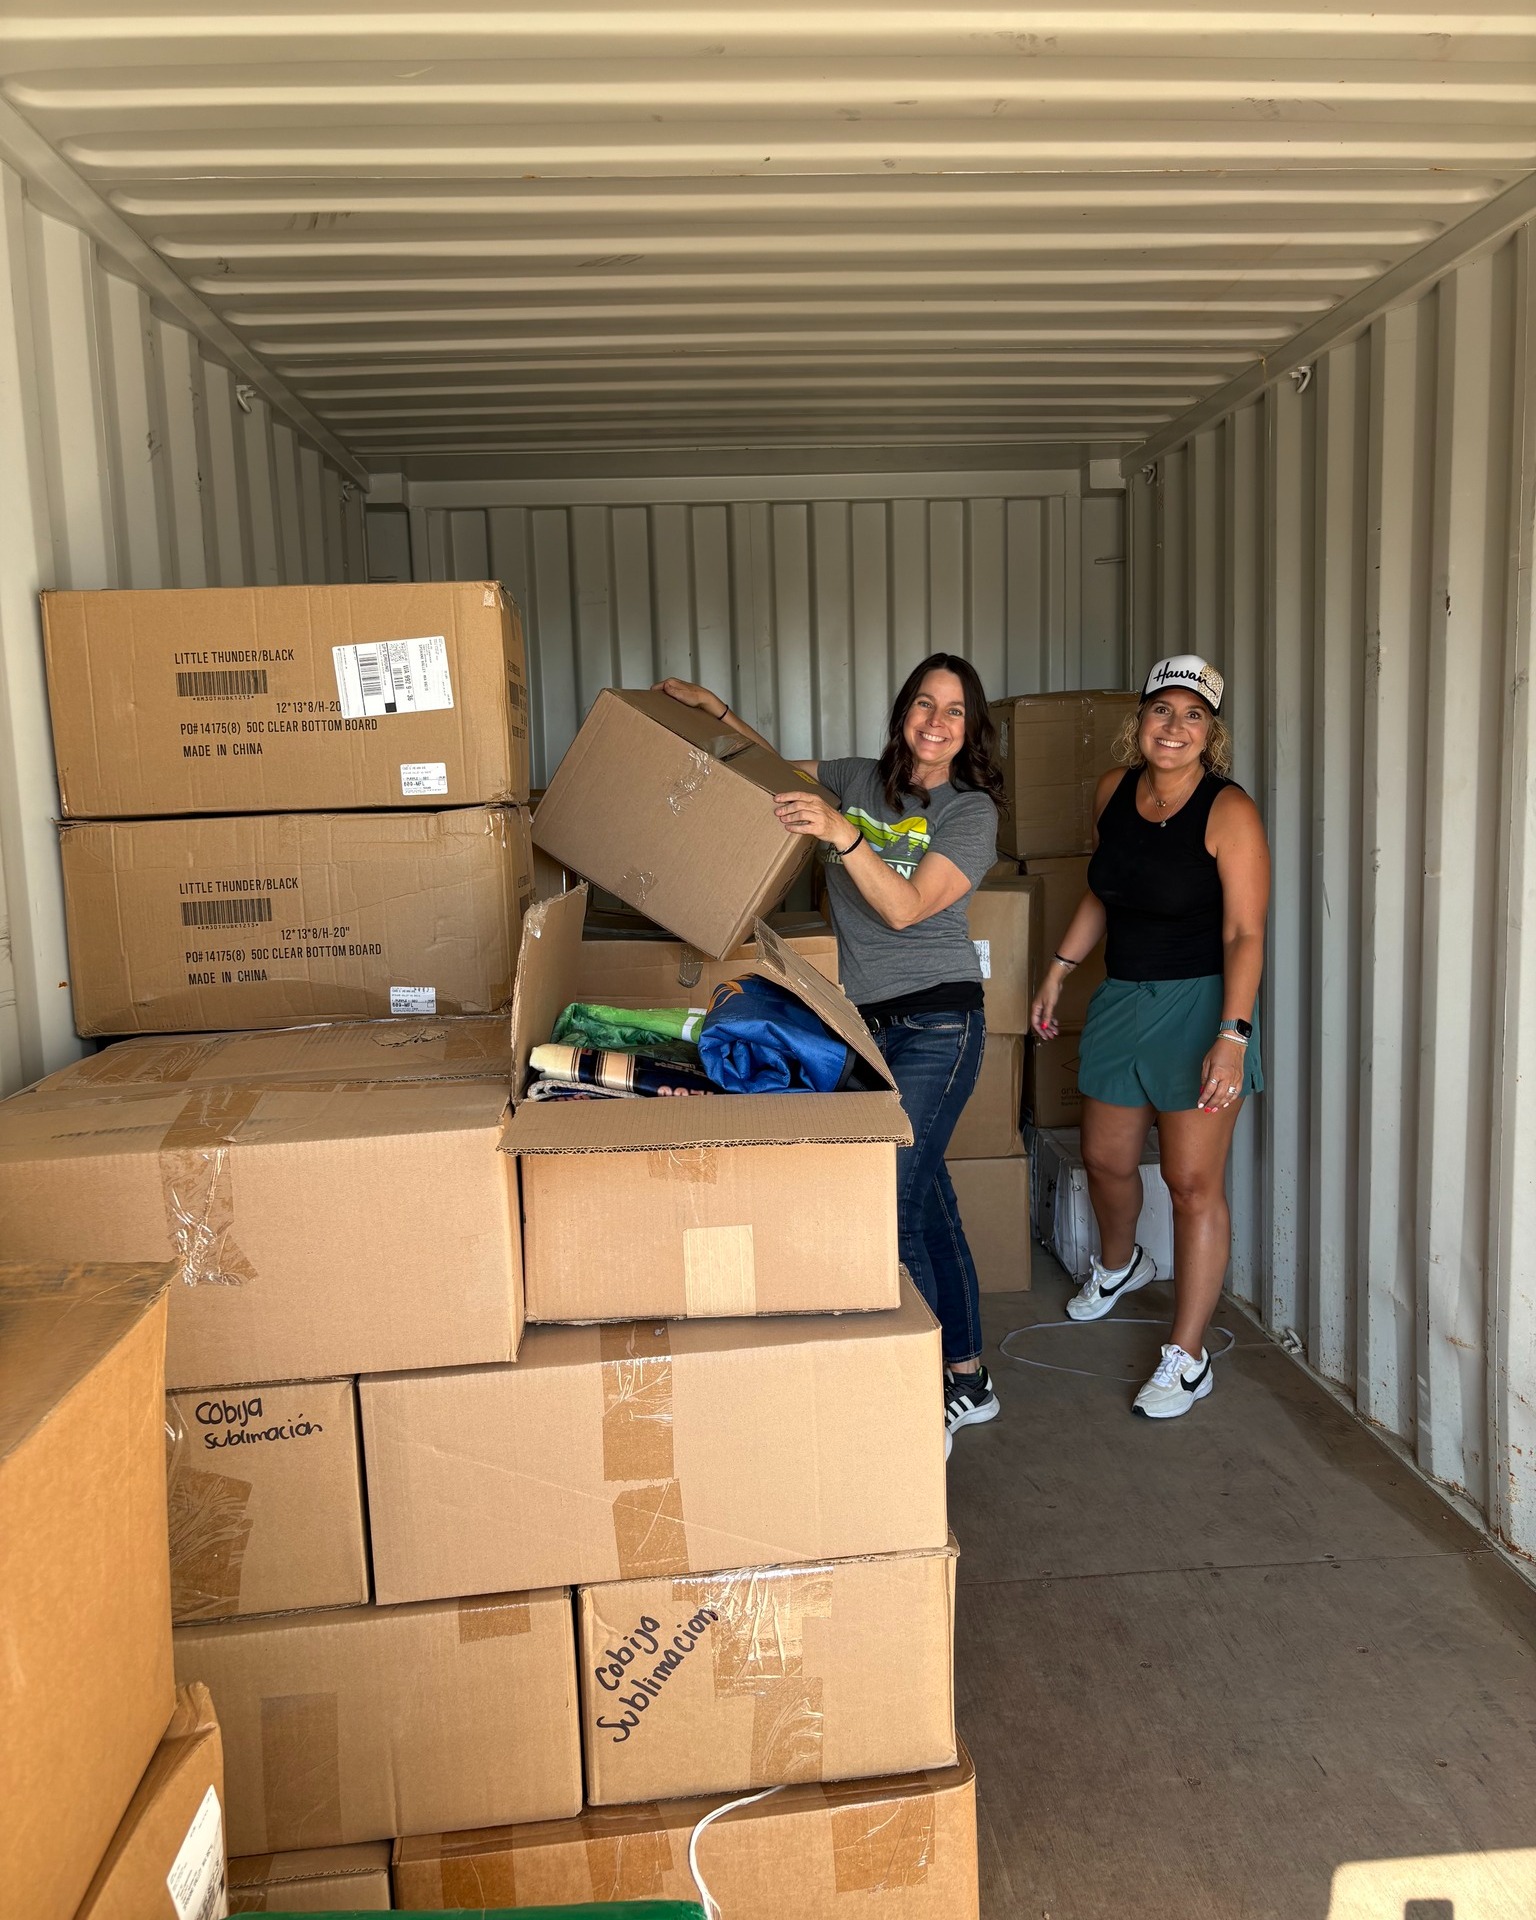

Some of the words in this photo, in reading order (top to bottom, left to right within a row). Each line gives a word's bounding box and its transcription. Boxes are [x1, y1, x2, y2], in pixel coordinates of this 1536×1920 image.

[174, 651, 209, 665] LITTLE
[211, 649, 295, 664] THUNDER/BLACK
[276, 700, 342, 714] 12138/H-20
[246, 721, 265, 734] 50C
[267, 720, 299, 733] CLEAR
[301, 719, 343, 732] BOTTOM
[345, 718, 378, 731] BOARD
[183, 744, 211, 758] MADE
[217, 743, 227, 756] IN
[233, 742, 263, 756] CHINA
[179, 881, 213, 895] LITTLE
[215, 877, 299, 893] THUNDER/BLACK
[251, 948, 270, 960] 50C
[272, 946, 303, 960] CLEAR
[306, 944, 347, 958] BOTTOM
[349, 943, 382, 956] BOARD
[188, 971, 216, 986] MADE
[222, 970, 232, 984] IN
[237, 969, 268, 983] CHINA
[594, 1615, 661, 1691] Cobija
